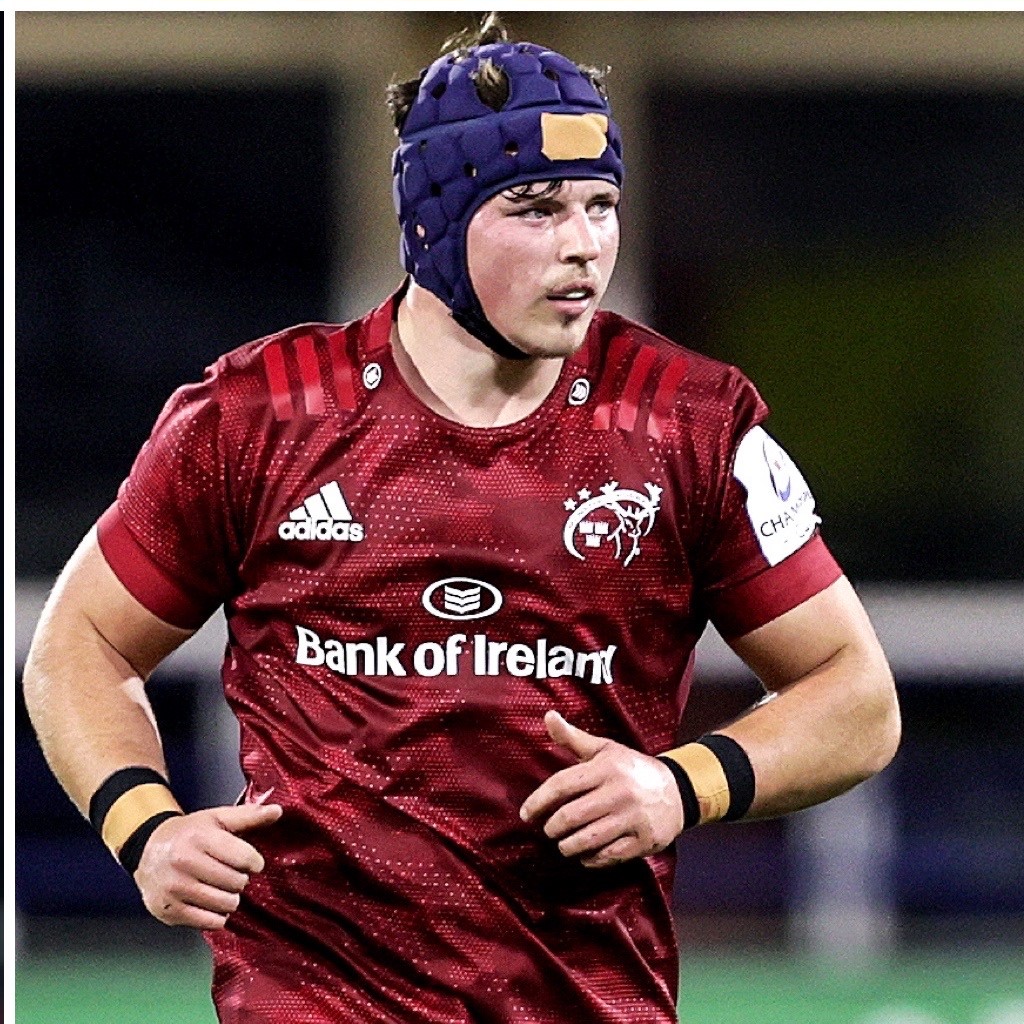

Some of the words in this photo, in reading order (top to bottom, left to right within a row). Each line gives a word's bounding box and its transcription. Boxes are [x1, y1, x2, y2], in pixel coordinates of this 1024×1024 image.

[278, 518, 365, 543] adidas
[295, 625, 407, 677] Bank
[413, 633, 467, 677] of
